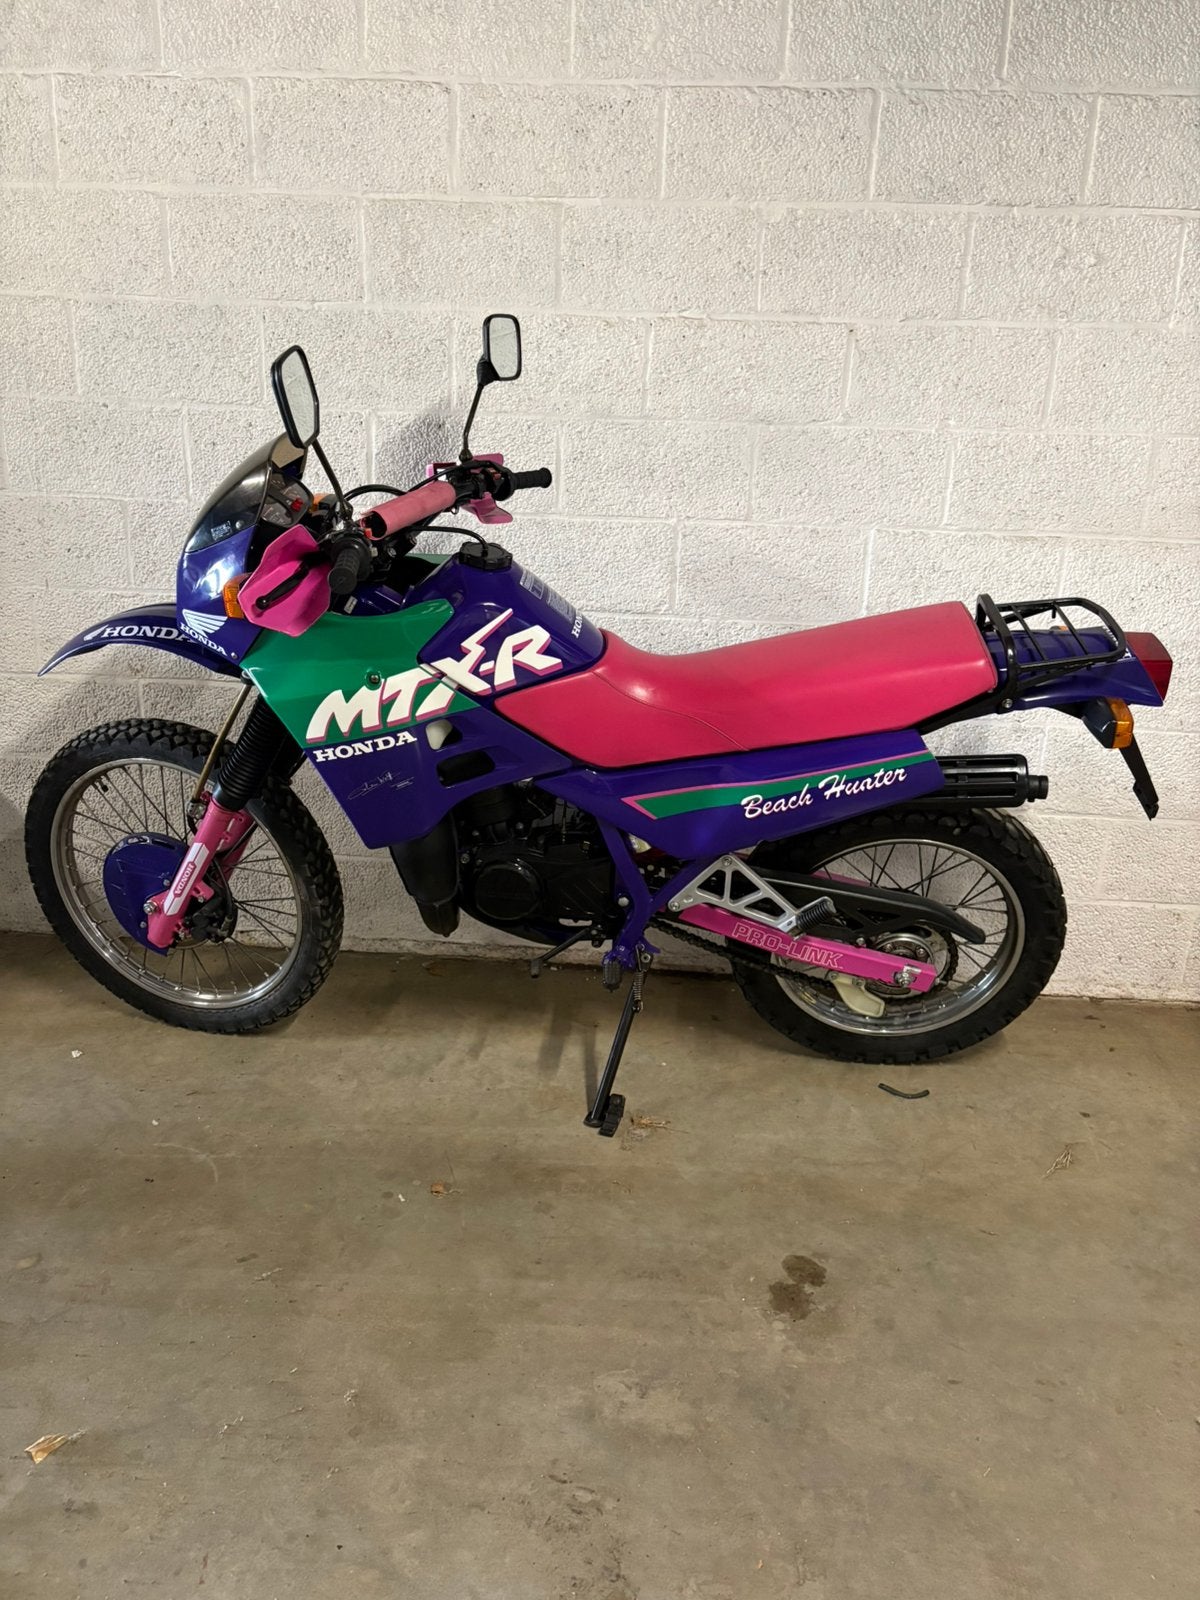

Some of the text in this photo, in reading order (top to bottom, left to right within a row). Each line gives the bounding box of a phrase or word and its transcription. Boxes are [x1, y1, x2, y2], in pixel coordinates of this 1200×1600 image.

[180, 622, 228, 656] HONDA
[313, 731, 417, 762] HONDA
[741, 767, 907, 819] Beach Hunter
[174, 864, 194, 894] HONDA
[731, 922, 844, 970] PRO-LINK
